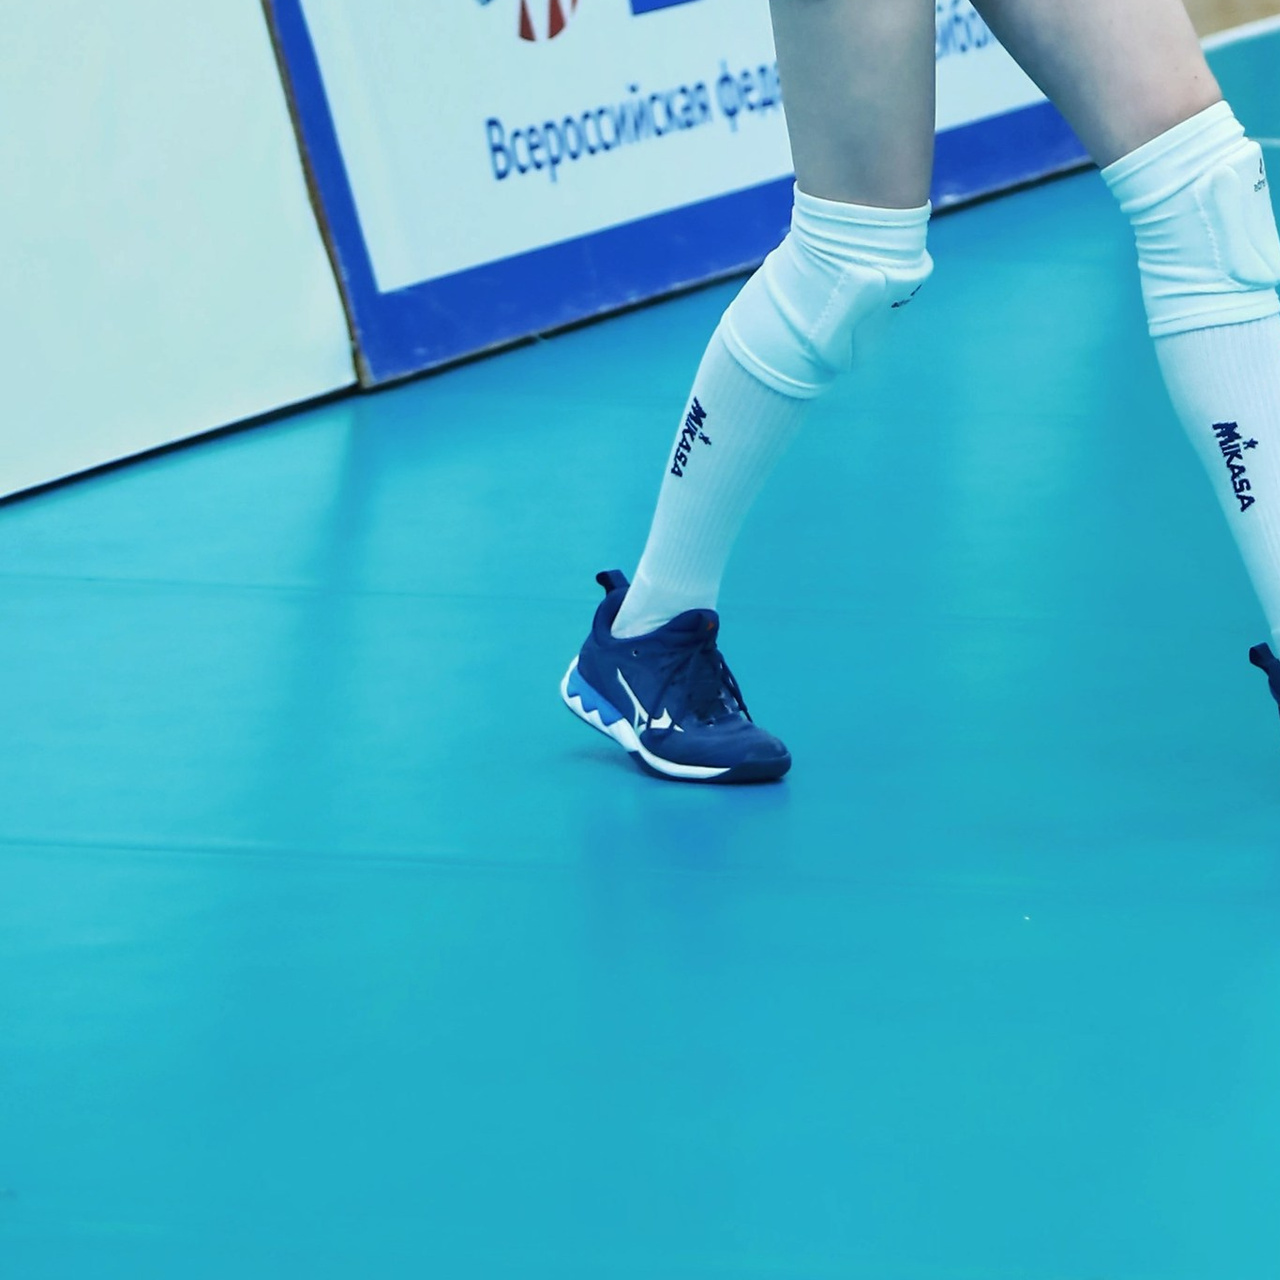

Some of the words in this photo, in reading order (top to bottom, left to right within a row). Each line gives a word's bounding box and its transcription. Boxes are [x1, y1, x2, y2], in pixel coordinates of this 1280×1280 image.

[486, 83, 713, 182] Всероссийская
[671, 396, 708, 478] MIKASA
[1212, 421, 1256, 513] MIKASA
